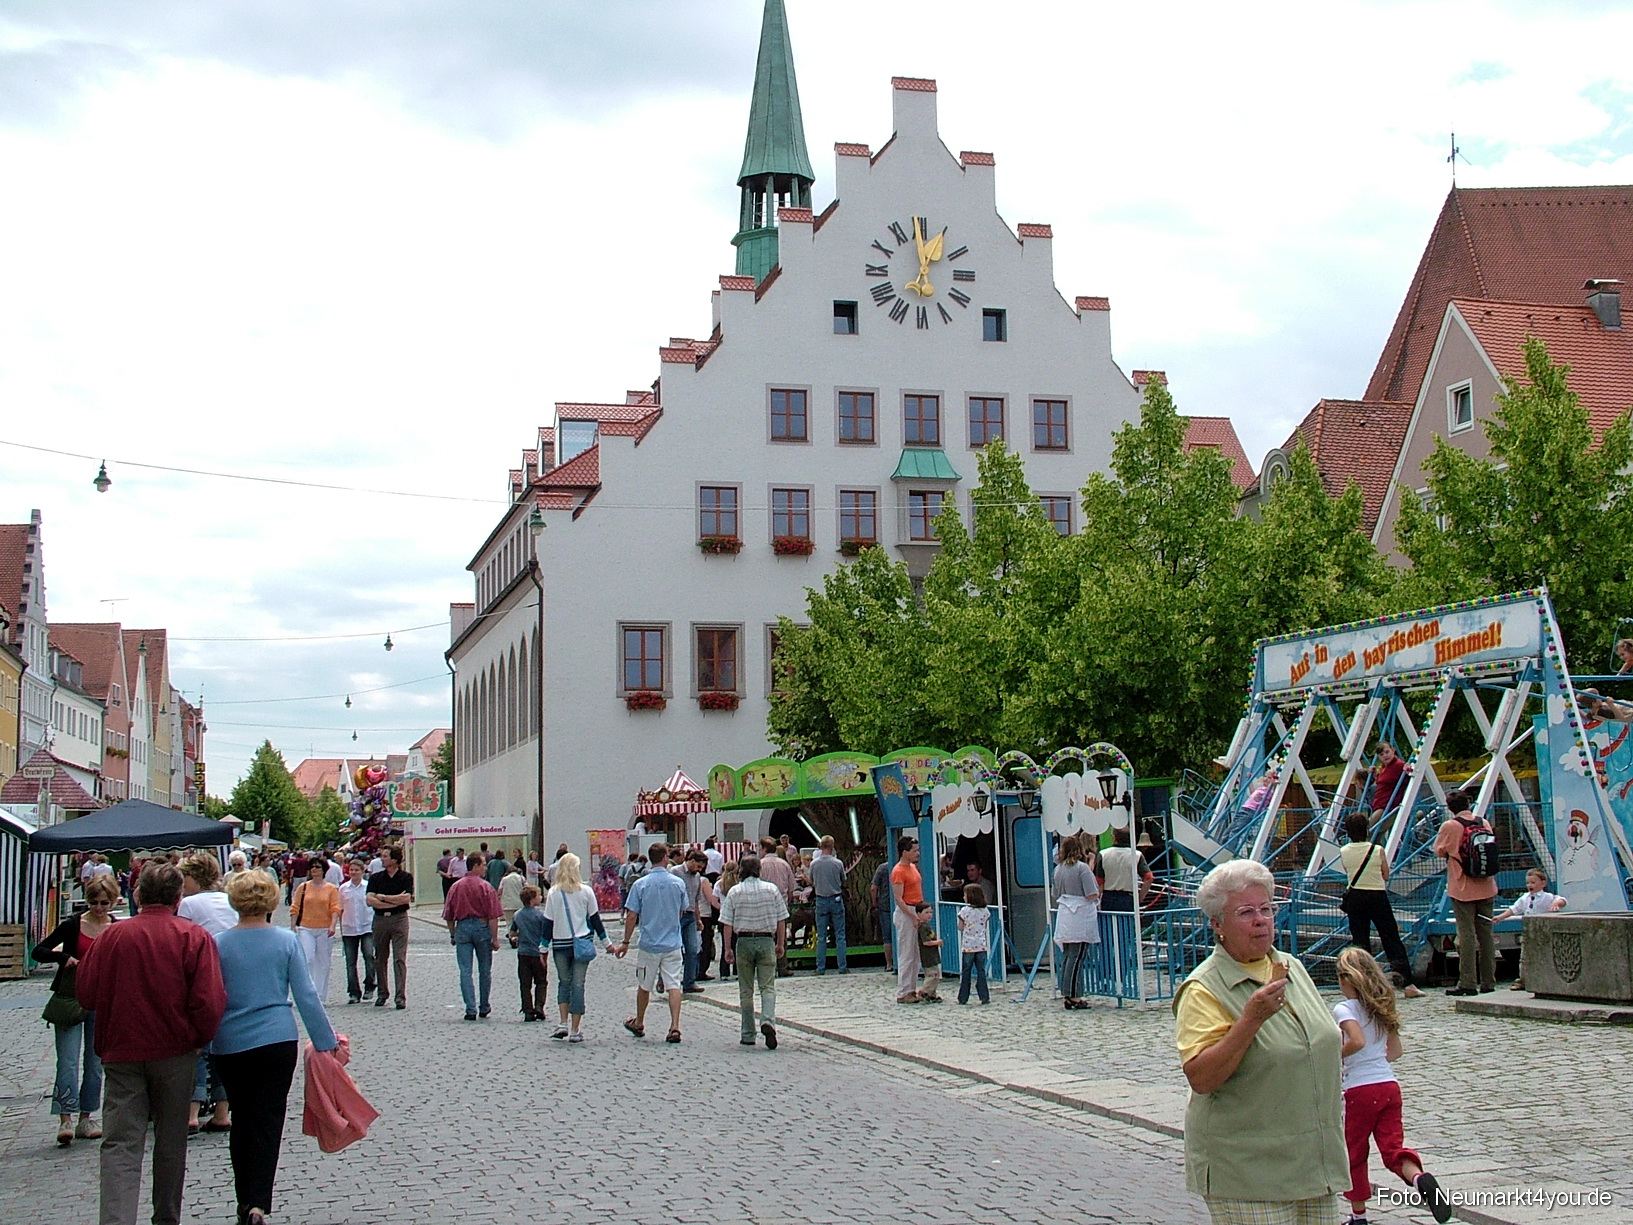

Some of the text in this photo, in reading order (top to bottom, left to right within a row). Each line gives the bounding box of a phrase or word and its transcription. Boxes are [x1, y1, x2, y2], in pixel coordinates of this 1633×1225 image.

[871, 239, 894, 259] X
[1289, 618, 1441, 687] Auf in den bayrischen
[1433, 620, 1503, 667] Himmel!
[196, 763, 205, 813] HOTEL
[434, 825, 507, 835] Geht Familie baden?
